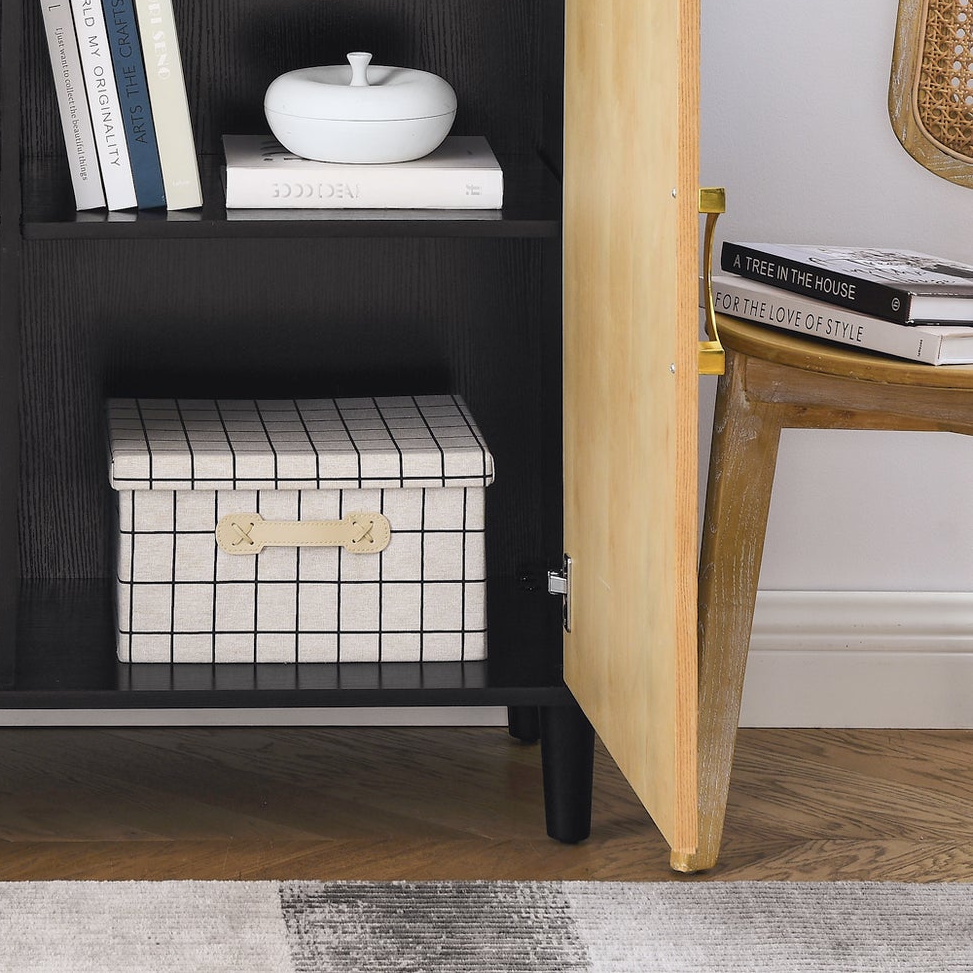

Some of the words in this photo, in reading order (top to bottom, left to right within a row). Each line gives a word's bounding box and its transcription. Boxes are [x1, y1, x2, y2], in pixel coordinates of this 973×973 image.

[55, 32, 65, 48] just
[88, 35, 101, 57] MY
[59, 49, 68, 67] want
[63, 69, 70, 78] to
[123, 65, 140, 99] THE
[65, 78, 75, 105] collect
[70, 105, 78, 118] the
[93, 66, 120, 166] ORIGINALITY
[129, 105, 148, 144] ARTS
[72, 119, 85, 156] beautiful
[78, 156, 88, 181] things
[732, 254, 741, 269] A
[745, 256, 775, 278] TREE
[776, 264, 789, 282] IN
[791, 268, 812, 288] THE
[814, 274, 856, 300] HOUSE
[715, 292, 739, 312] FOR
[742, 296, 766, 319] THE
[769, 302, 802, 327] LOVE
[804, 313, 823, 332] OF
[825, 318, 864, 343] STYLE
